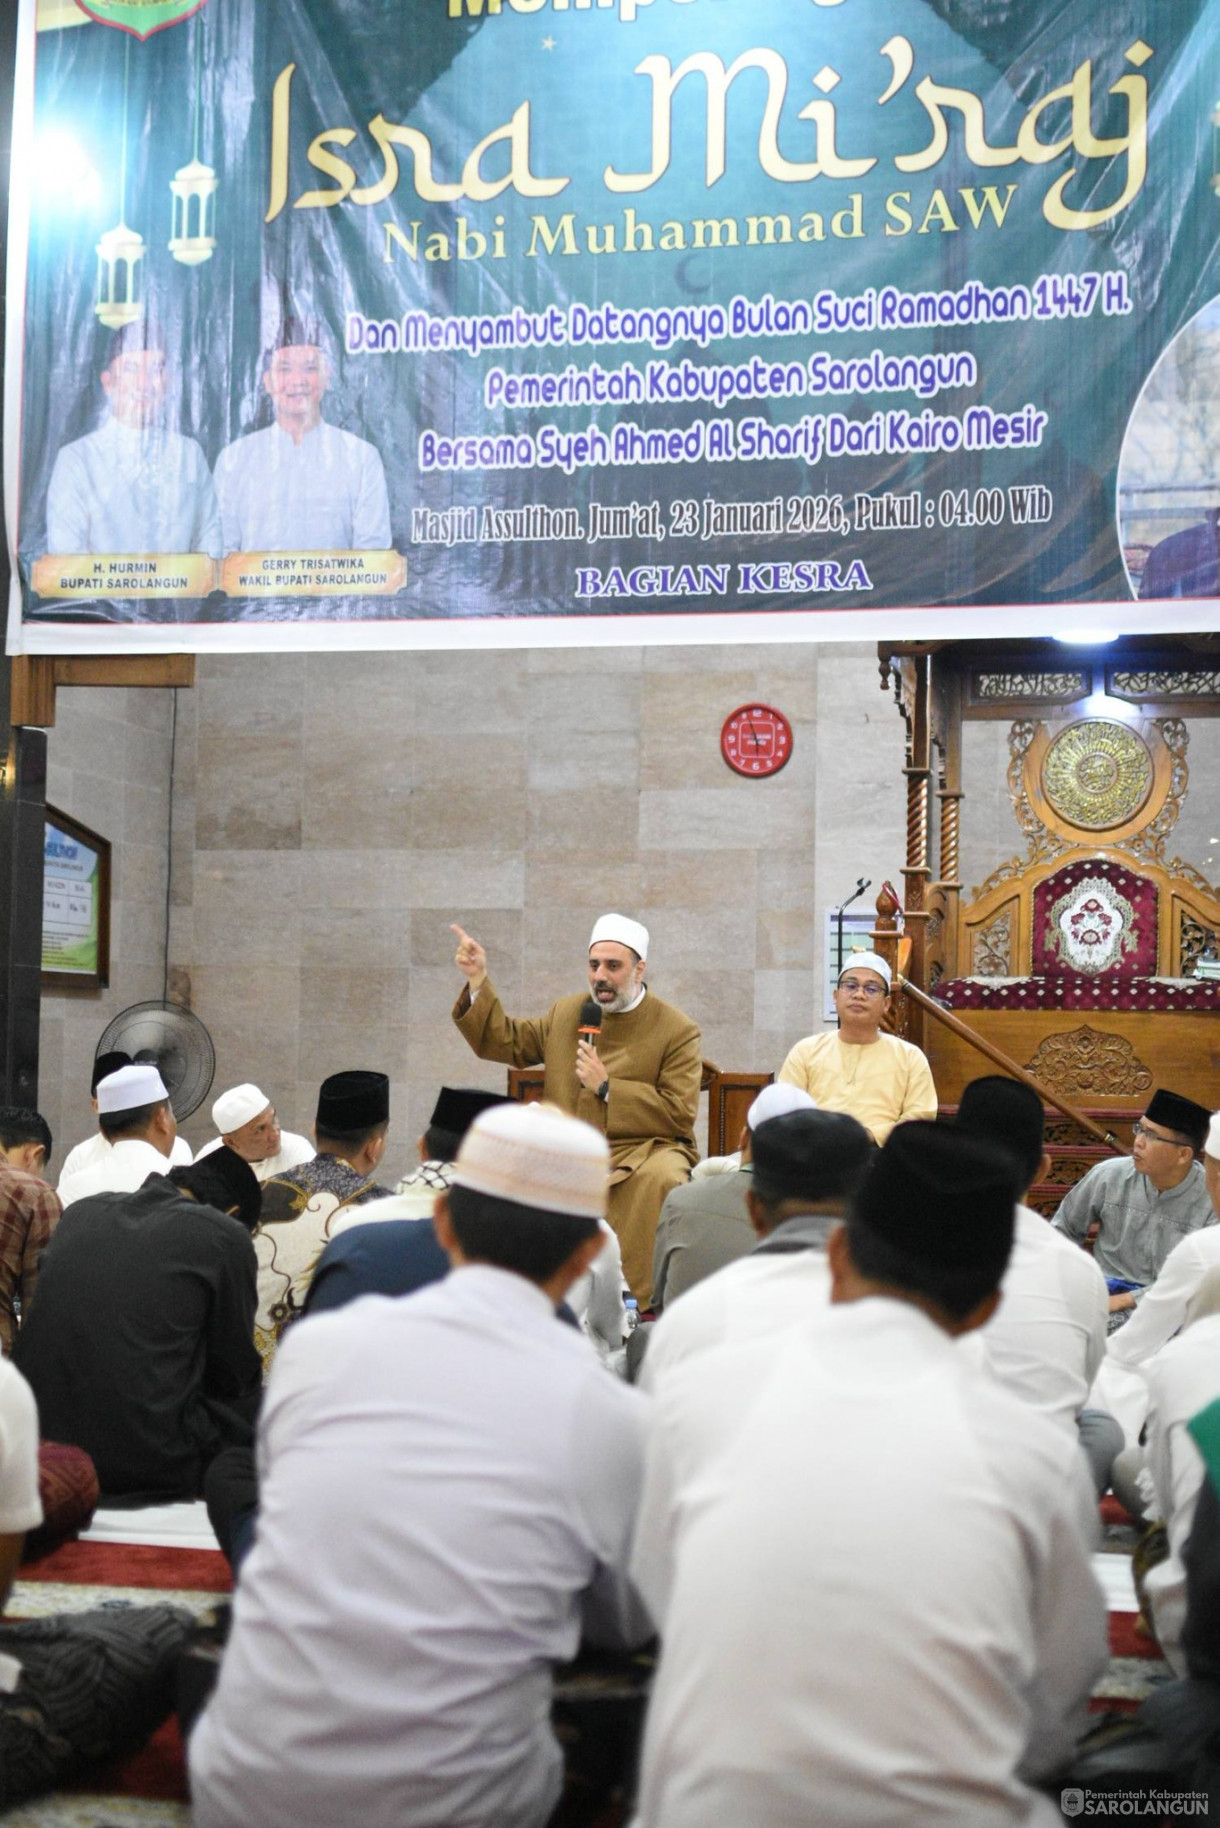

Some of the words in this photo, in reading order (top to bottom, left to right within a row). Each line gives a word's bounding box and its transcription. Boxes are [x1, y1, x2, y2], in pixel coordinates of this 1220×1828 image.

[265, 63, 570, 223] Isra
[603, 35, 1155, 231] Mi'raj
[383, 215, 507, 264] Nabi
[526, 193, 865, 258] Muhammad
[885, 184, 1018, 238] SAW
[347, 313, 399, 352] Dan
[404, 305, 567, 356] Menyambut
[570, 303, 727, 348] Datangnya
[730, 296, 811, 336] Bulan
[815, 290, 876, 331] Suci
[879, 283, 1030, 327] Ramadhan
[1034, 274, 1099, 317] 1447
[1103, 272, 1132, 314] H.
[486, 362, 643, 408] Pemerintah
[647, 356, 806, 407] Kabupaten
[809, 350, 976, 397] Sarolangun
[420, 430, 535, 471] Bersama
[538, 424, 610, 474] Syeh
[612, 419, 703, 465] Ahmed
[706, 419, 735, 462] Al
[738, 416, 824, 465] Sharif
[826, 412, 884, 455] Dari
[887, 409, 961, 454] Kairo
[963, 404, 1047, 449] Mesir
[412, 505, 477, 546] Masjid
[481, 503, 585, 542] Assulthon.
[588, 501, 666, 543] Jum'at,
[671, 500, 699, 537] 23
[702, 497, 783, 540] Januari
[786, 494, 850, 535] 2026,
[855, 492, 920, 531] Pukul
[939, 488, 1005, 527] 04.00
[1008, 485, 1052, 524] Wib
[60, 578, 103, 589] BUPATI
[106, 577, 188, 589] SAROLANGUN
[93, 562, 105, 574] H.
[109, 562, 157, 574] HURMIN
[239, 575, 272, 586] WAKIL
[275, 574, 312, 586] BUPATI
[315, 573, 387, 585] SAROLANGUN
[262, 559, 297, 571] GERRY
[300, 558, 365, 570] TRISATWIKA
[575, 564, 730, 597] BAGIAN
[737, 559, 874, 594] KESRA
